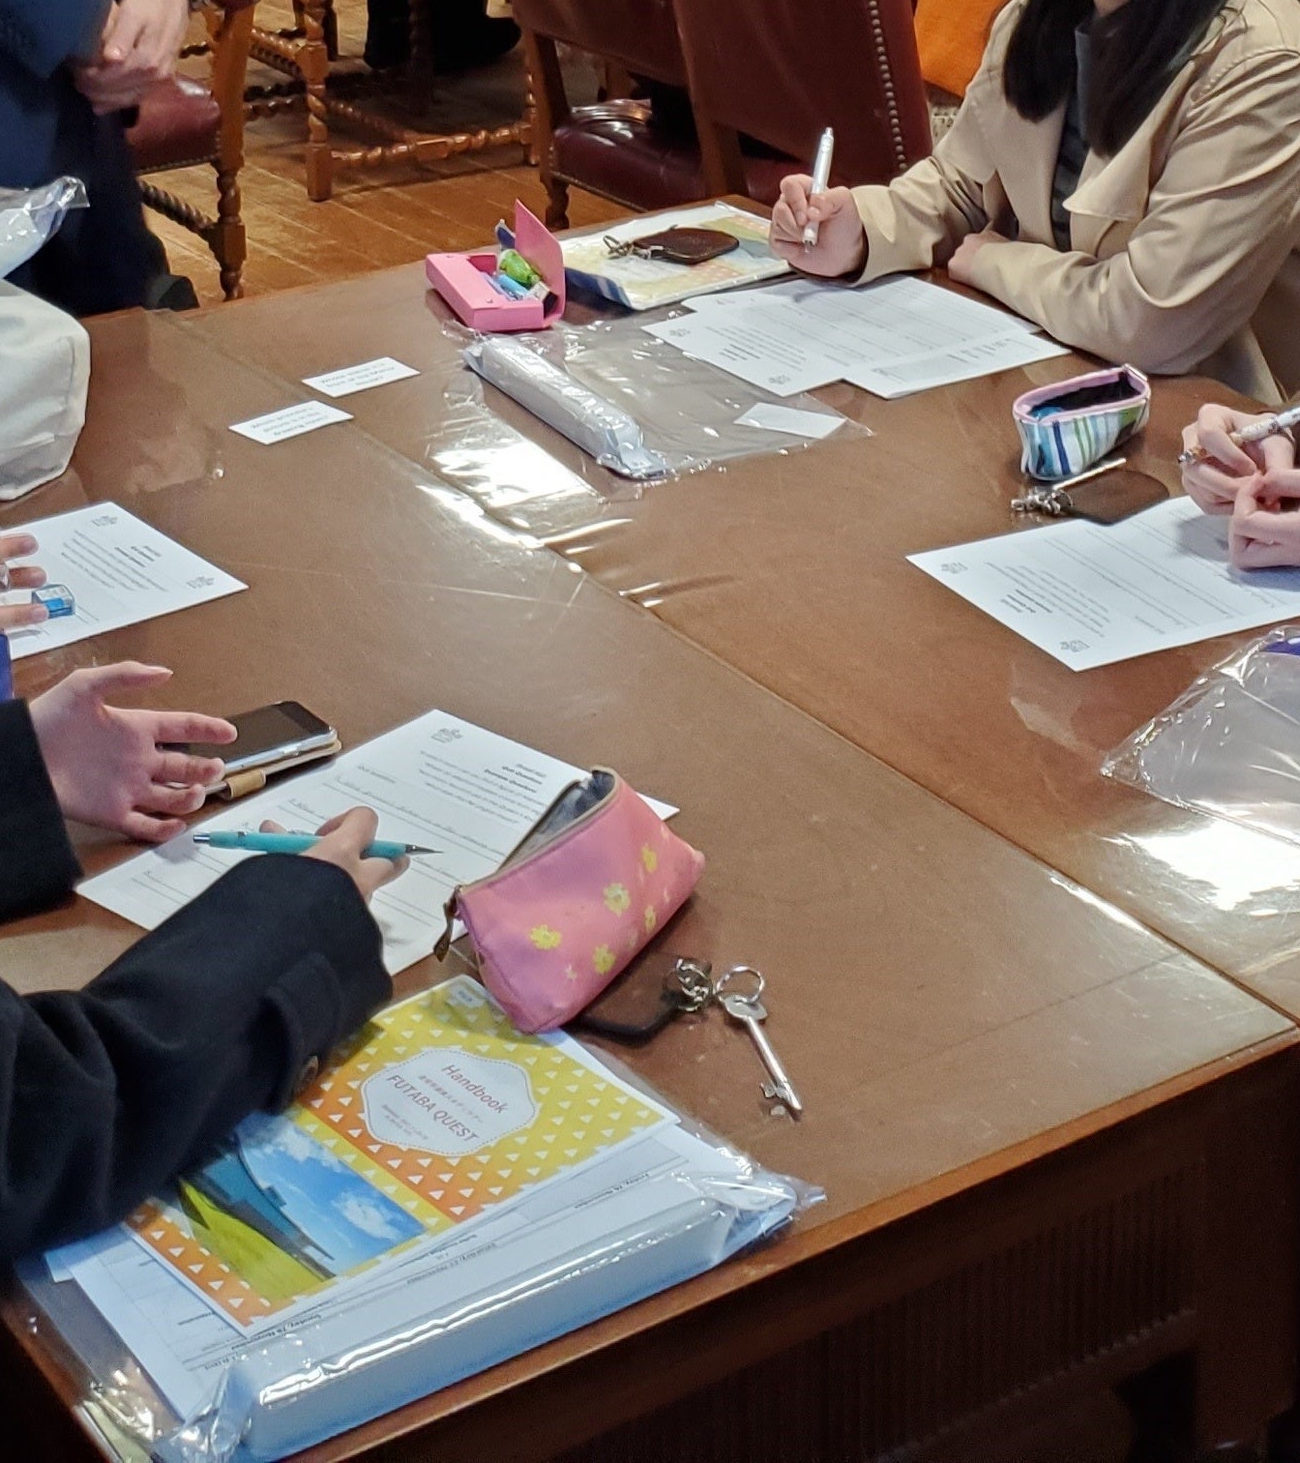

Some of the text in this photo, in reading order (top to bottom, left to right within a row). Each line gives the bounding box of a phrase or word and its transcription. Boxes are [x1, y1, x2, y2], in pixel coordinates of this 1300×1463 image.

[386, 1074, 437, 1112] FUTABA
[433, 1108, 479, 1143] QUEST
[441, 1063, 509, 1114] Handbook
